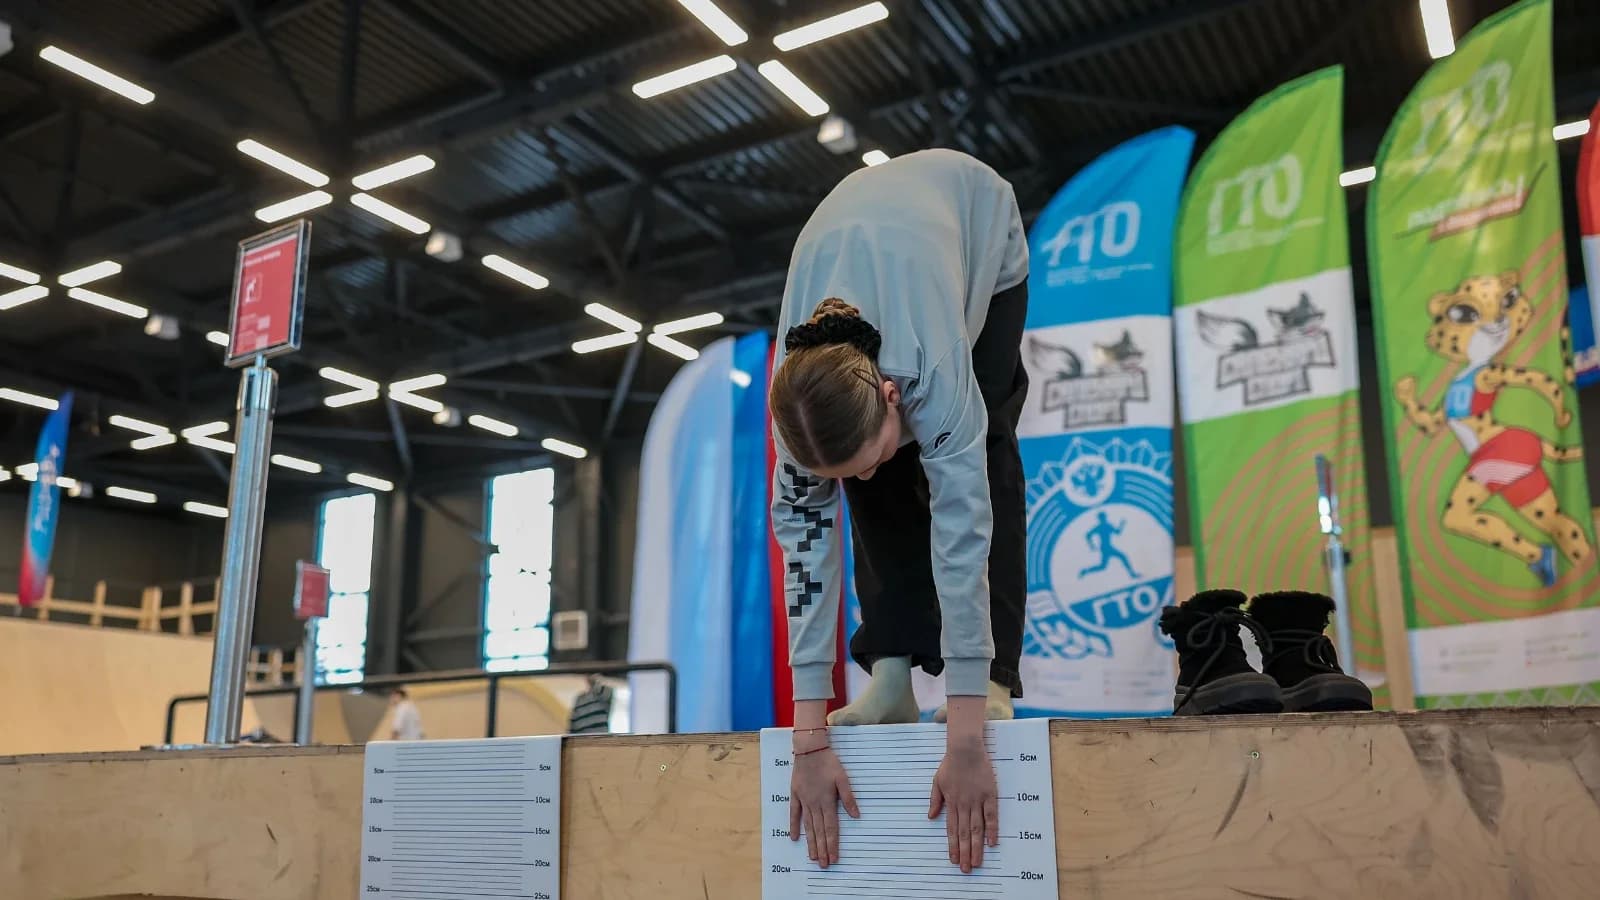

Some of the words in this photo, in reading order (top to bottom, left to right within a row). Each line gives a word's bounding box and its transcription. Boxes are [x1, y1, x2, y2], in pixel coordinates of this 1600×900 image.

[1092, 584, 1159, 626] ГТО
[1019, 753, 1037, 762] 5см
[774, 759, 790, 767] 5см
[771, 794, 790, 802] 10см
[1017, 793, 1040, 801] 10см
[535, 827, 550, 835] 15см
[1019, 832, 1042, 840] 15см
[772, 865, 791, 873] 20см
[1021, 871, 1044, 880] 20см
